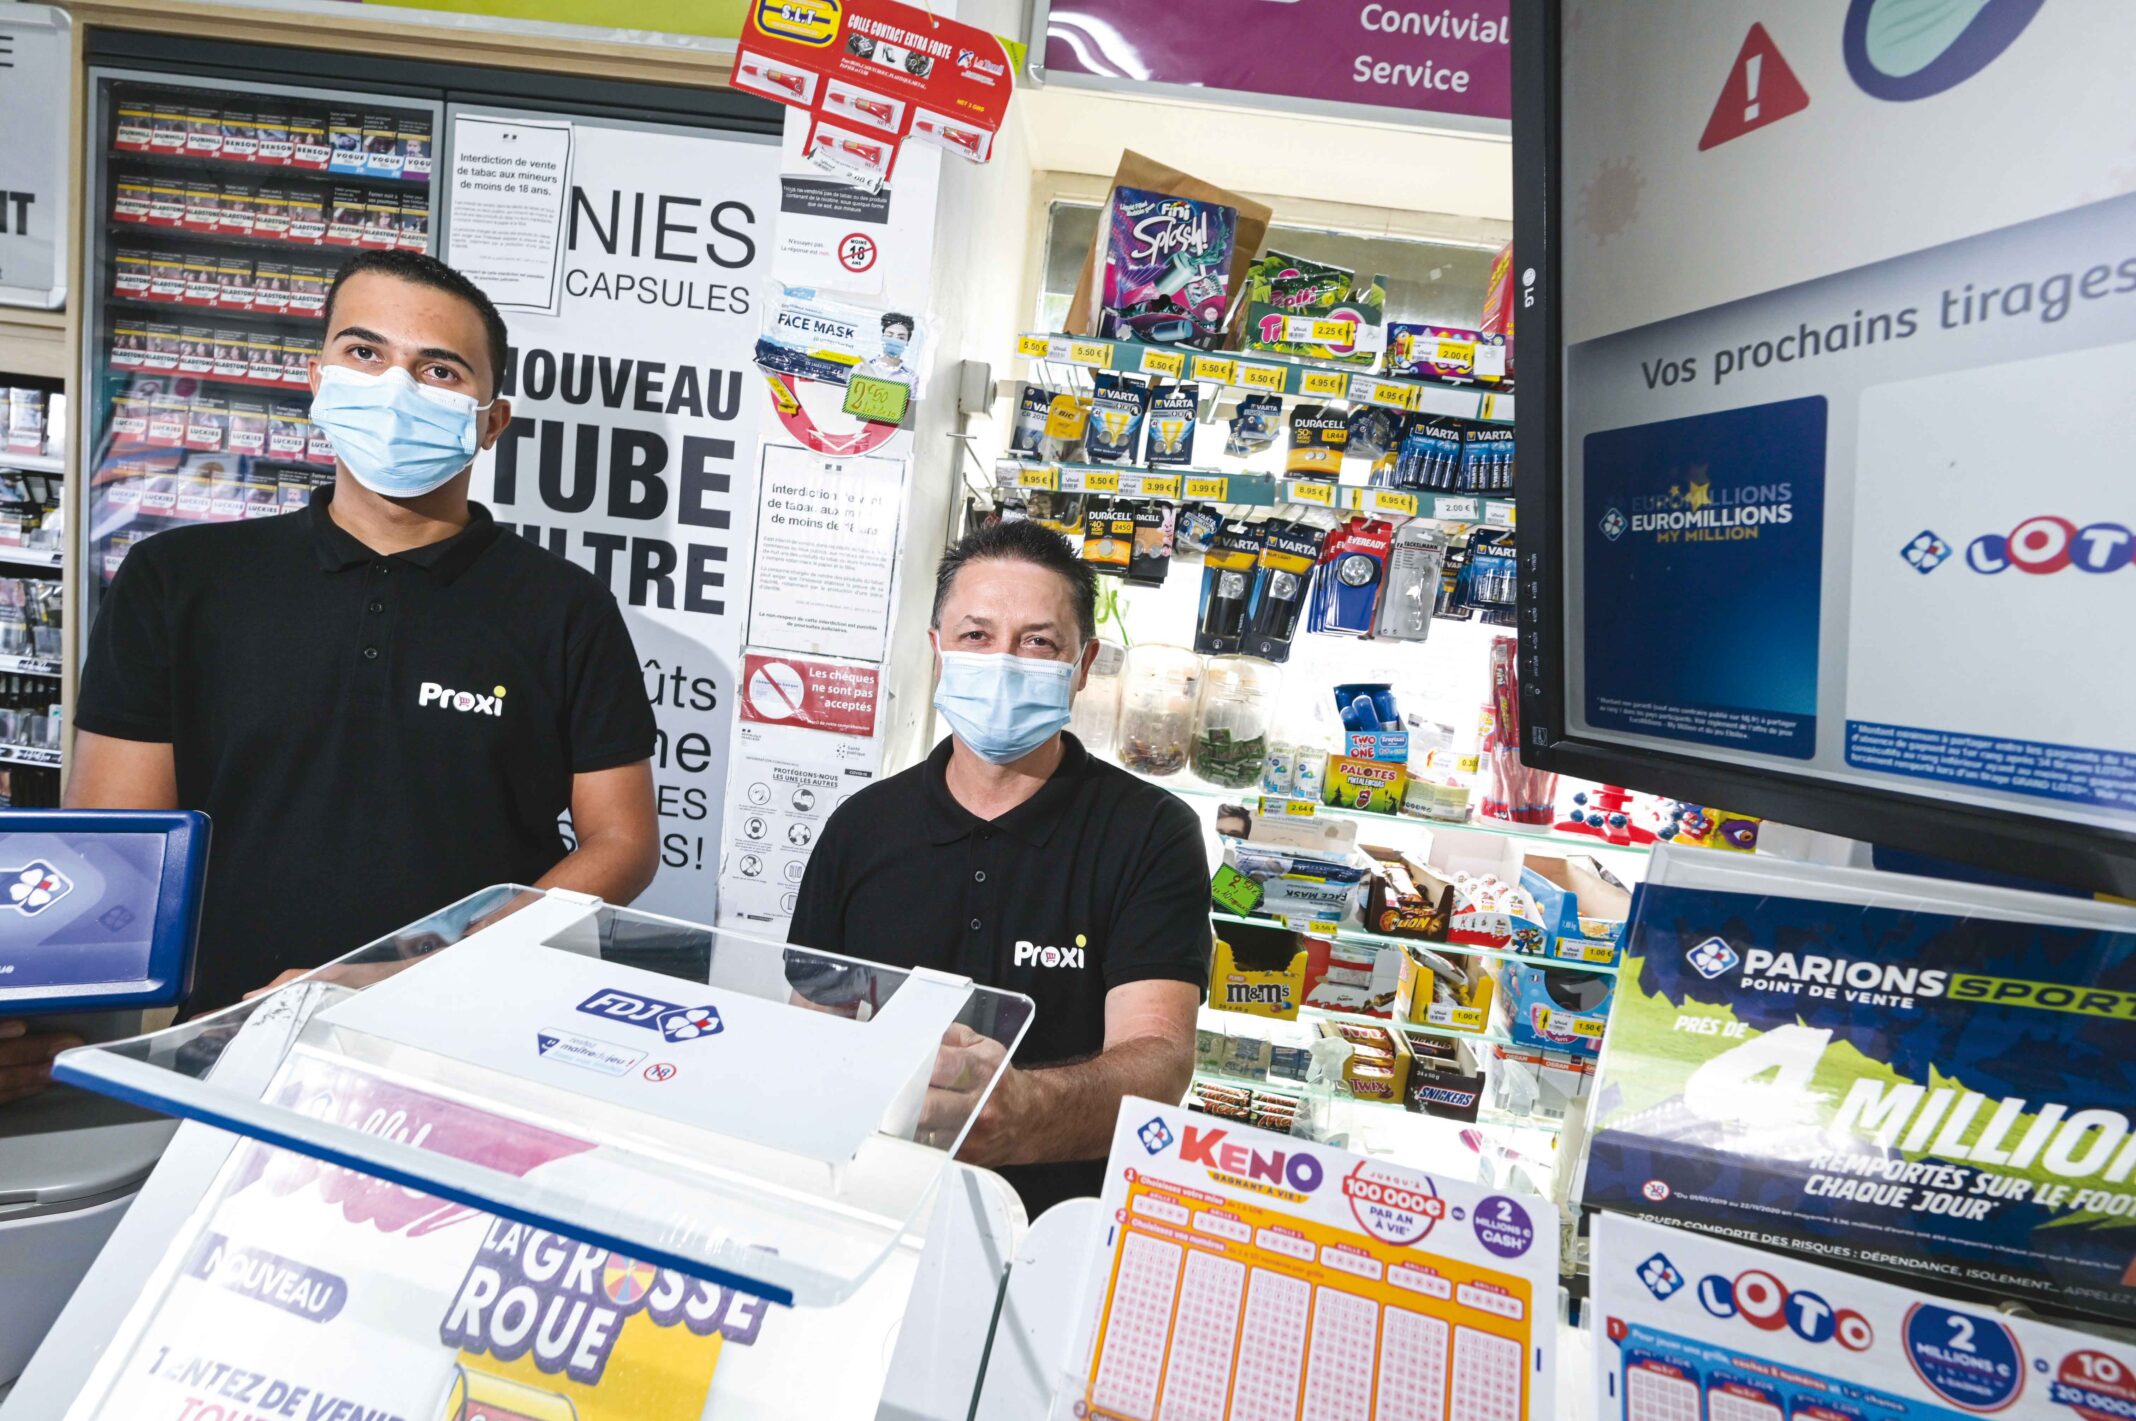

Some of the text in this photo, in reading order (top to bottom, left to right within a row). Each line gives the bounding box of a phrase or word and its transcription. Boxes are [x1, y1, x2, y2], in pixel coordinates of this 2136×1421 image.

[781, 5, 817, 25] S.L.T
[1360, 3, 1510, 45] Convivial
[848, 14, 953, 59] COLLE CONTACT EXTRA FORTE
[1352, 55, 1470, 93] Service
[154, 132, 185, 141] DUNHILL
[190, 135, 221, 144] DUNHILL
[225, 139, 257, 148] BENSON
[260, 143, 293, 152] BENSON
[297, 146, 329, 156] BENSON
[336, 152, 364, 161] VOGUE
[372, 156, 400, 165] VOGUE
[460, 153, 557, 170] Interdiction de vente
[457, 166, 558, 184] de tabac aux mineurs
[460, 180, 471, 189] de
[474, 181, 502, 191] moins
[504, 183, 516, 193] de
[519, 184, 529, 193] 18
[1161, 203, 1190, 221] Fini
[567, 185, 757, 269] NIES
[1131, 211, 1208, 266] Splash!
[849, 245, 865, 260] 18
[565, 269, 750, 315] CAPSULES
[1523, 286, 1535, 308] LG
[1941, 260, 2136, 329] tirages
[778, 313, 856, 339] FACE MASK
[1318, 326, 1336, 336] 2.25
[1023, 341, 1040, 351] 5.50
[1077, 347, 1095, 357] 5.50
[1642, 309, 1918, 390] Vos prochains
[1442, 350, 1460, 360] 2.00
[1149, 360, 1166, 370] 5.50
[1201, 363, 1218, 373] 5.50
[1250, 373, 1268, 383] 5.50
[1310, 378, 1328, 388] 4.95
[1107, 390, 1140, 403] VARTA
[1379, 390, 1397, 400] 4.95
[1162, 399, 1194, 408] VARTA
[1257, 403, 1278, 411] VARTA
[1295, 418, 1345, 429] DURACELL
[190, 428, 219, 437] LUCKIES
[1425, 426, 1460, 441] VARTA
[1477, 430, 1513, 441] VARTA
[273, 437, 303, 446] LUCKIES
[493, 416, 736, 530] TUBE
[1023, 475, 1041, 484] 4.95
[1090, 476, 1107, 485] 5.50
[1147, 482, 1165, 491] 3.99
[1192, 483, 1209, 492] 3.99
[1299, 485, 1316, 495] 8.95
[767, 498, 782, 509] de
[1381, 495, 1399, 505] 6.95
[248, 505, 277, 513] LUCKIES
[1446, 504, 1463, 512] 2.00
[771, 514, 824, 529] de moins
[1088, 511, 1132, 521] DURACELL
[1197, 513, 1216, 526] VARTA
[1631, 504, 1793, 532] EUROMILLIONS
[1656, 527, 1759, 543] MY MILLION
[1222, 537, 1260, 551] VARTA
[1278, 539, 1317, 556] VARTA
[1347, 536, 1386, 550] EVEREADY
[1404, 540, 1438, 550] FACKELMANN
[1966, 515, 2136, 576] LOT
[809, 667, 827, 678] Les
[811, 683, 826, 693] ne
[827, 684, 851, 696] sont
[854, 688, 874, 699] pas
[418, 682, 507, 717] Proxi
[824, 698, 872, 713] acceptés
[1351, 735, 1376, 745] TWO
[1350, 747, 1375, 759] ONE
[773, 767, 839, 782] PROTÉGEONS-NOUS
[1340, 764, 1396, 781] PALOTES
[772, 773, 838, 788] LES UNS LES AUTRES
[1291, 803, 1307, 812] 2.64
[1286, 889, 1347, 901] FACE MASK
[1399, 918, 1431, 930] LION
[1014, 933, 1087, 969] Proxi
[1590, 948, 1606, 956] 1.00
[1743, 948, 1948, 998] PARIONS
[1226, 983, 1290, 1003] m&m's
[1740, 977, 1915, 1009] POINT DE VENTE
[585, 993, 666, 1021] FDJ
[1457, 1012, 1473, 1020] 1.00
[1578, 1023, 1595, 1031] 1.50
[1721, 1019, 1750, 1039] DE
[1505, 1054, 1528, 1062] OSRAM
[1545, 1061, 1569, 1070] OSRAM
[1684, 1022, 1836, 1122] 4
[1350, 1078, 1387, 1093] Twix
[1418, 1086, 1474, 1107] SNICKERS
[1178, 1124, 1324, 1193] KENO
[1370, 1171, 1421, 1189] JUSQU'À
[1809, 1151, 1970, 1193] REMPORTÉS
[1975, 1170, 2031, 1199] SUR
[2033, 1177, 2070, 1206] LE
[1140, 1176, 1224, 1205] Choisissez votre mise
[1213, 1173, 1265, 1192] GAGNANT
[1277, 1189, 1295, 1200] VIE
[1803, 1173, 1908, 1211] CHAQUE
[1346, 1180, 1442, 1217] 100 000€
[1370, 1206, 1414, 1225] PAR AN
[1496, 1201, 1512, 1222] 2
[1740, 1202, 1781, 1214] 22/11/2020
[1793, 1211, 1831, 1224] moyenne
[1130, 1217, 1174, 1236] Choisissez
[1174, 1231, 1188, 1242] vos
[1375, 1218, 1384, 1229] À
[1475, 1216, 1521, 1236] MILLIONS
[1683, 1219, 1759, 1242] COMPORTE
[1761, 1234, 1789, 1247] DES
[1791, 1240, 1851, 1258] RISQUES
[1860, 1249, 1963, 1278] DÉPENDANCE,
[203, 1246, 334, 1315] NOUVEAU
[445, 1264, 618, 1371] ROUE
[1697, 1269, 1874, 1352] LOTO
[1632, 1329, 1656, 1343] Pour
[1946, 1315, 1977, 1353] 2
[1916, 1342, 1995, 1375] MILLIONS
[2077, 1354, 2122, 1384] 10
[257, 1379, 311, 1418] DE
